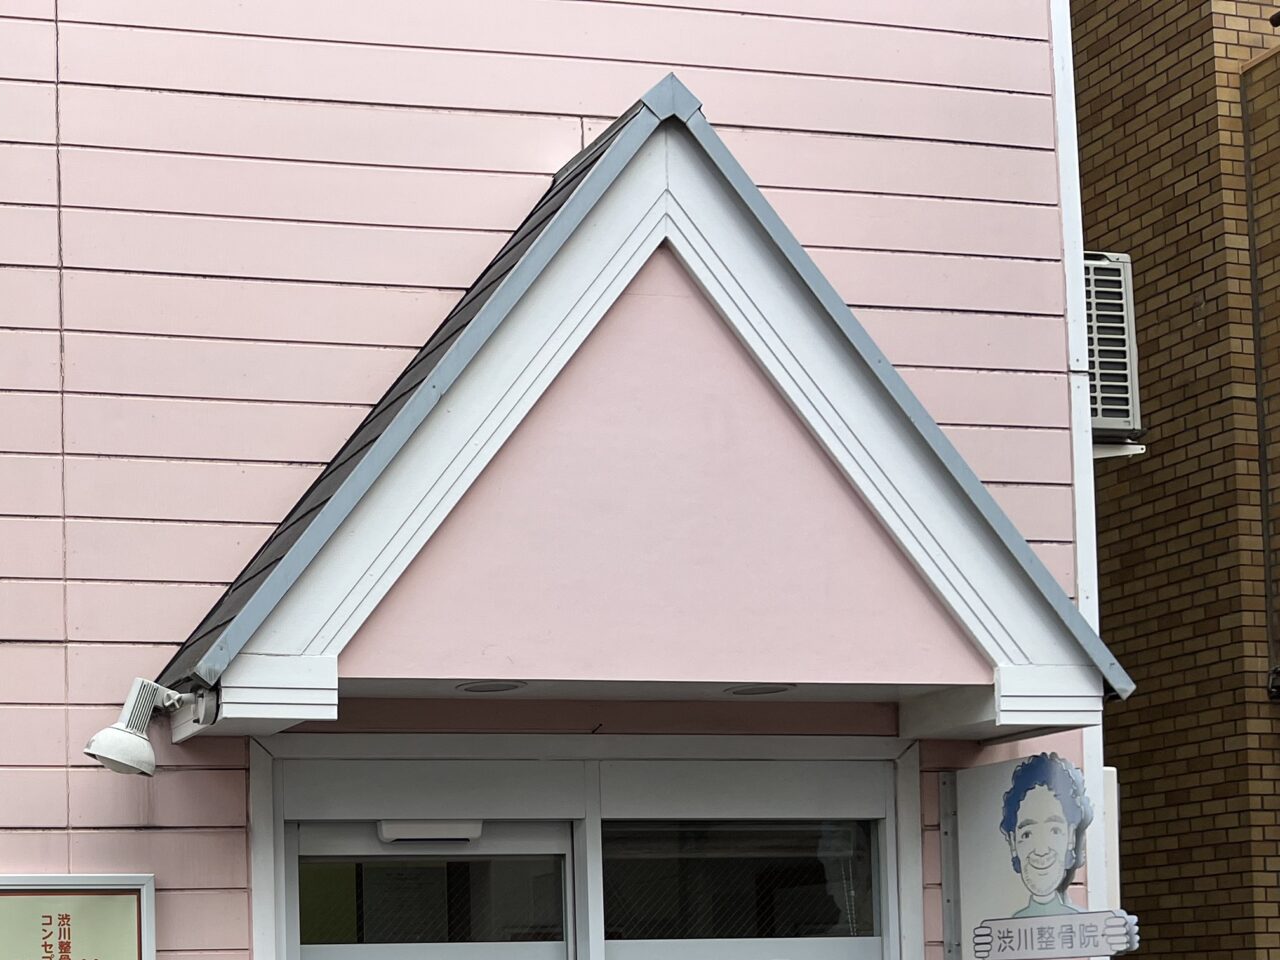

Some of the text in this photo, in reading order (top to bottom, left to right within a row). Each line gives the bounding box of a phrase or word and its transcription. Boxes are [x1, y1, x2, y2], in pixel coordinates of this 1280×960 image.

[997, 923, 1099, 952] 渋川整骨院
